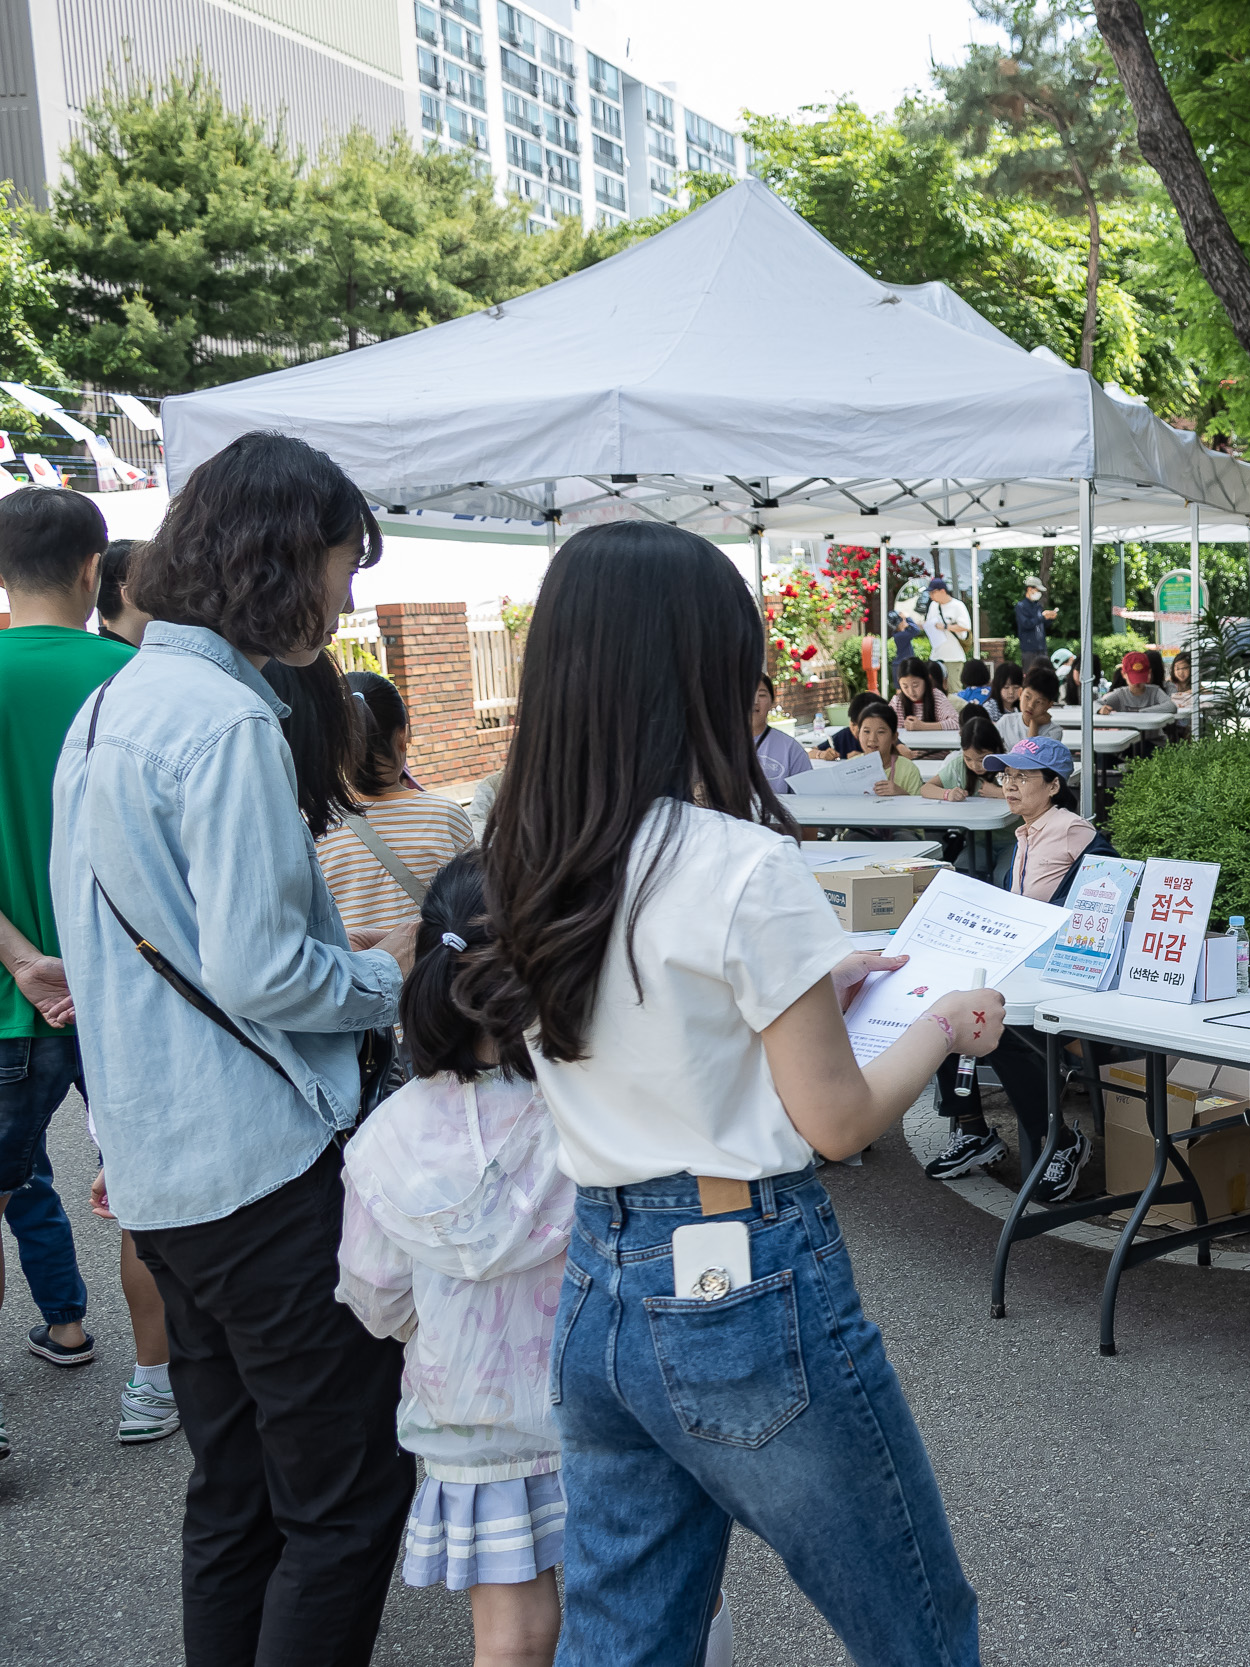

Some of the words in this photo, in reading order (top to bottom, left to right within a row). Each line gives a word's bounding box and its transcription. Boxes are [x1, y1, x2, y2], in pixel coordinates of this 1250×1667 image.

[1163, 876, 1194, 891] 백일장
[1151, 894, 1194, 924] 접수
[1142, 931, 1187, 963] 마감
[1129, 966, 1160, 983] (선착순
[1163, 972, 1185, 986] 마감)
